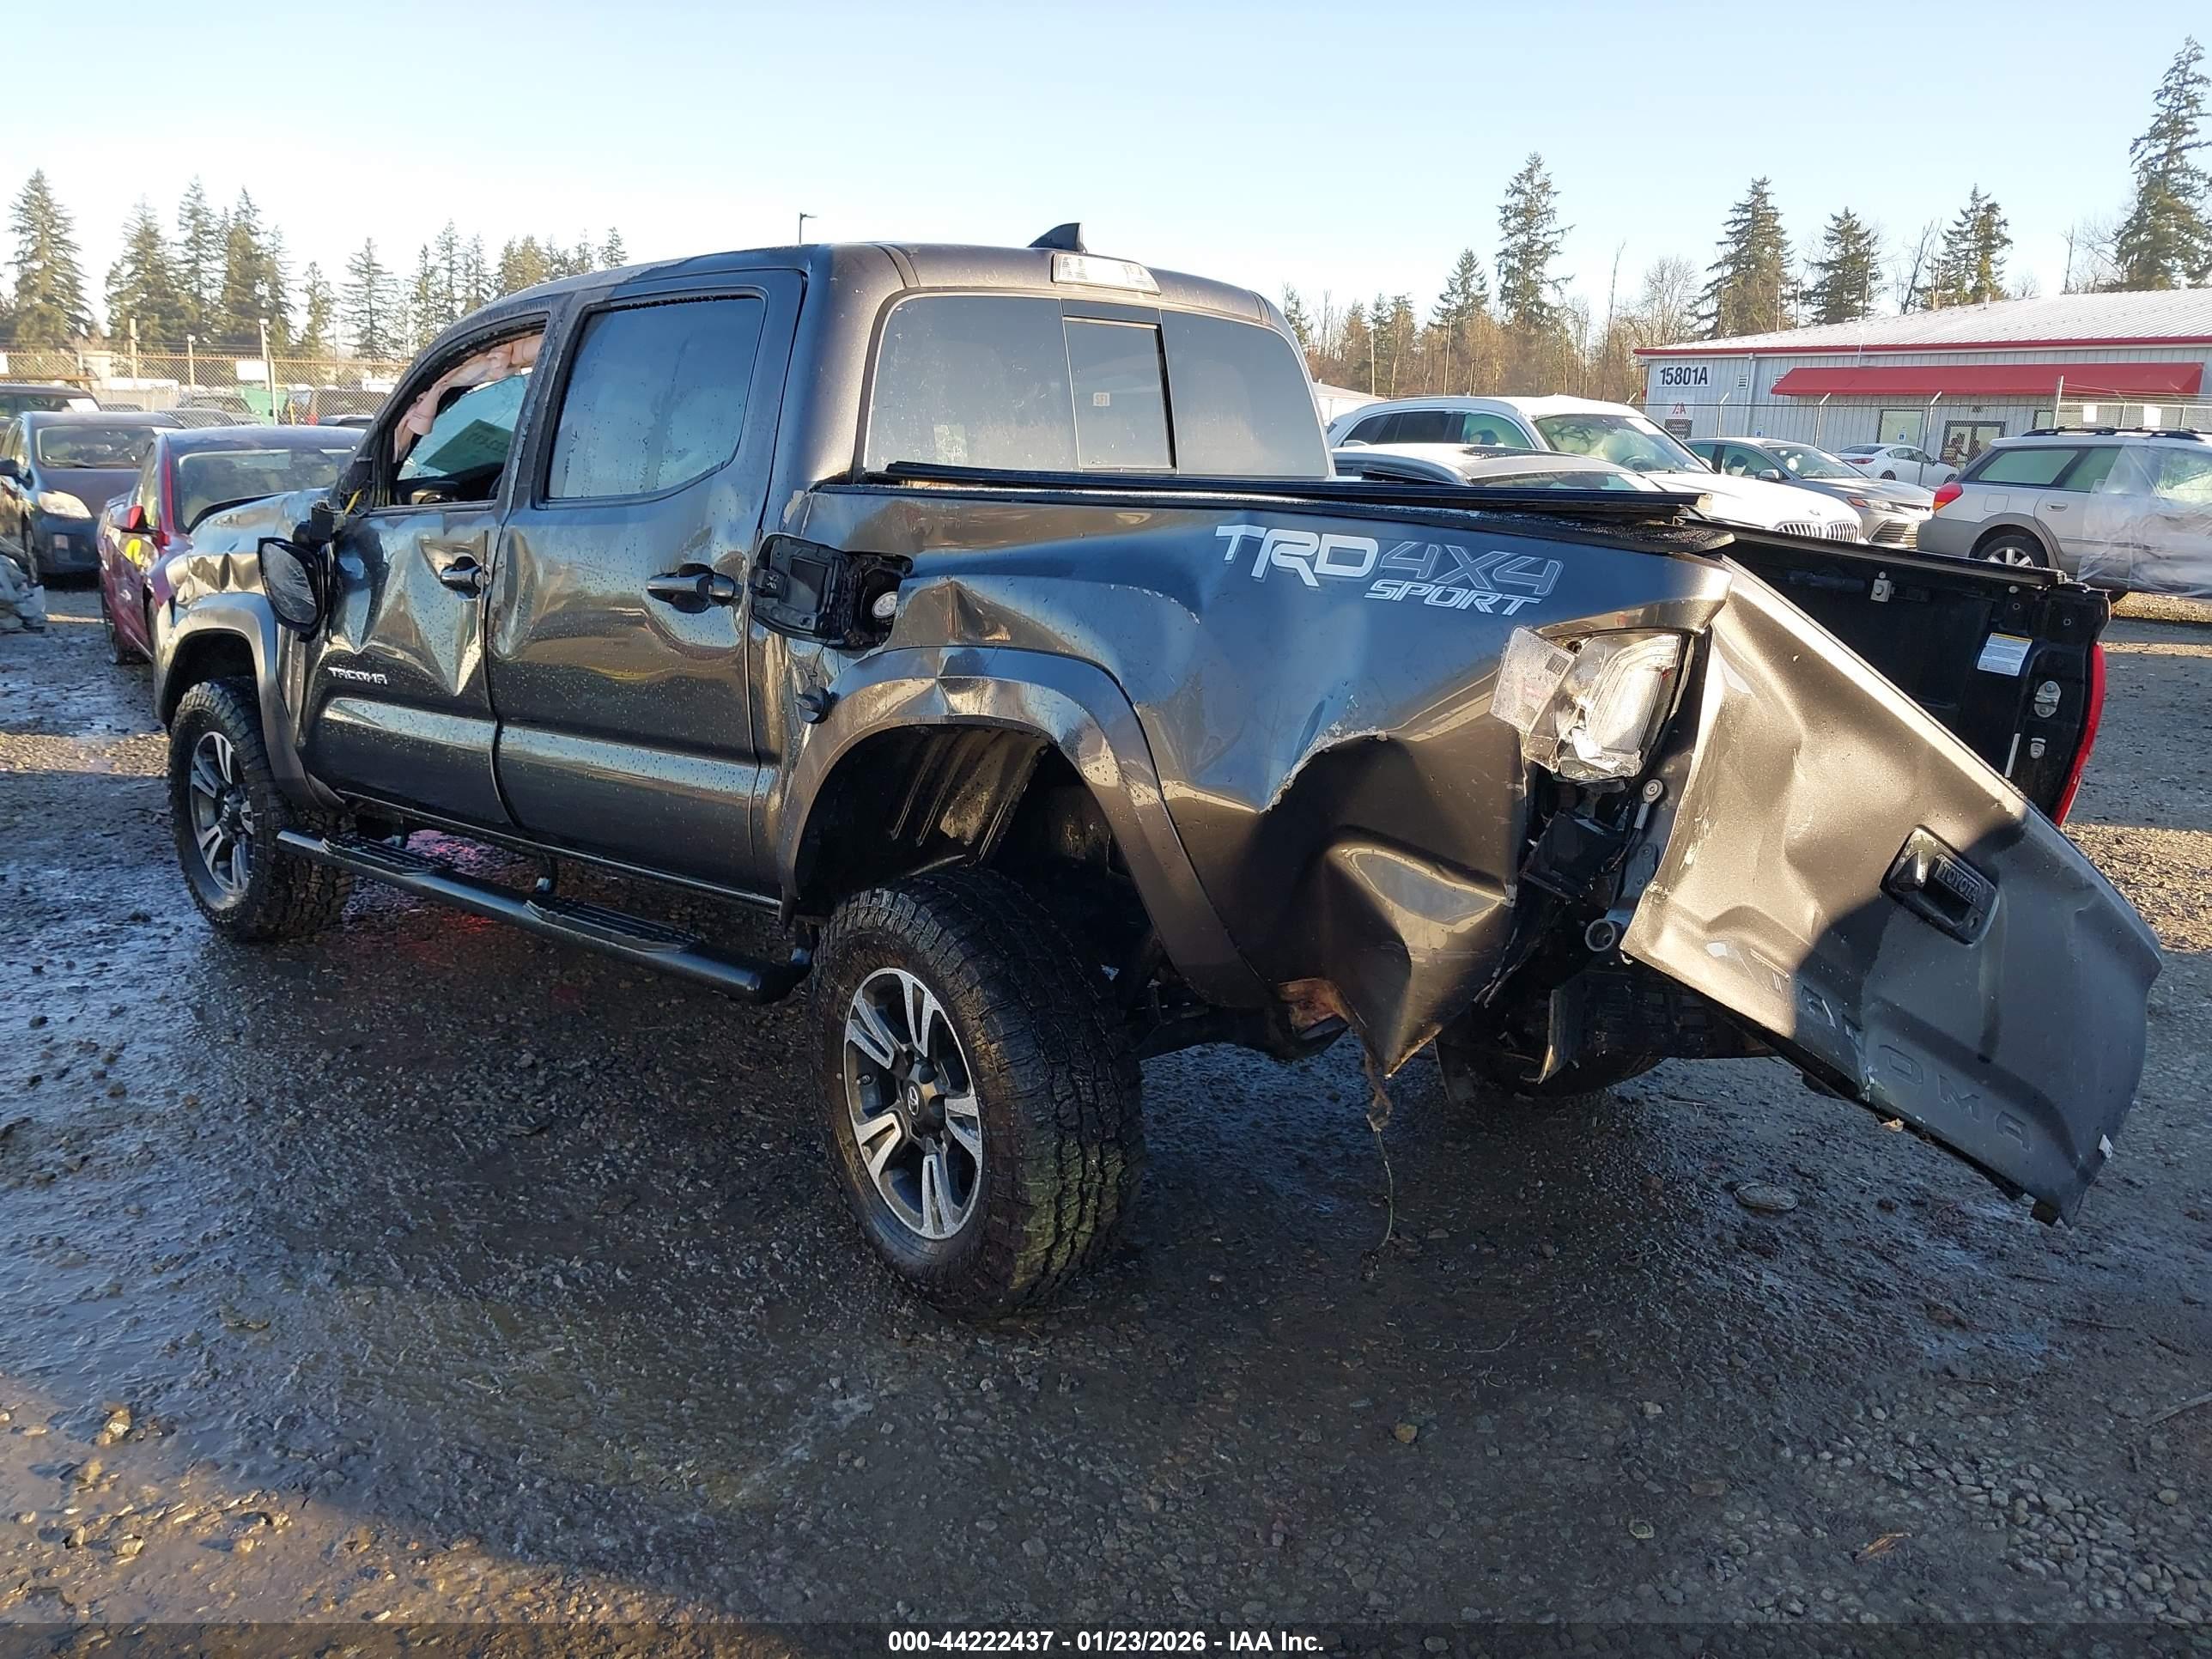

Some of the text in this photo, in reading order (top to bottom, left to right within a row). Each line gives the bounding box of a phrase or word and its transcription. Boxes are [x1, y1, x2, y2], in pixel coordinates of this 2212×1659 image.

[1659, 366, 1708, 385] 15801A
[1215, 524, 1380, 590] TRD
[1364, 579, 1542, 617] SPORT
[327, 666, 388, 685] TACOMA
[1940, 863, 1980, 902] TOYOTA
